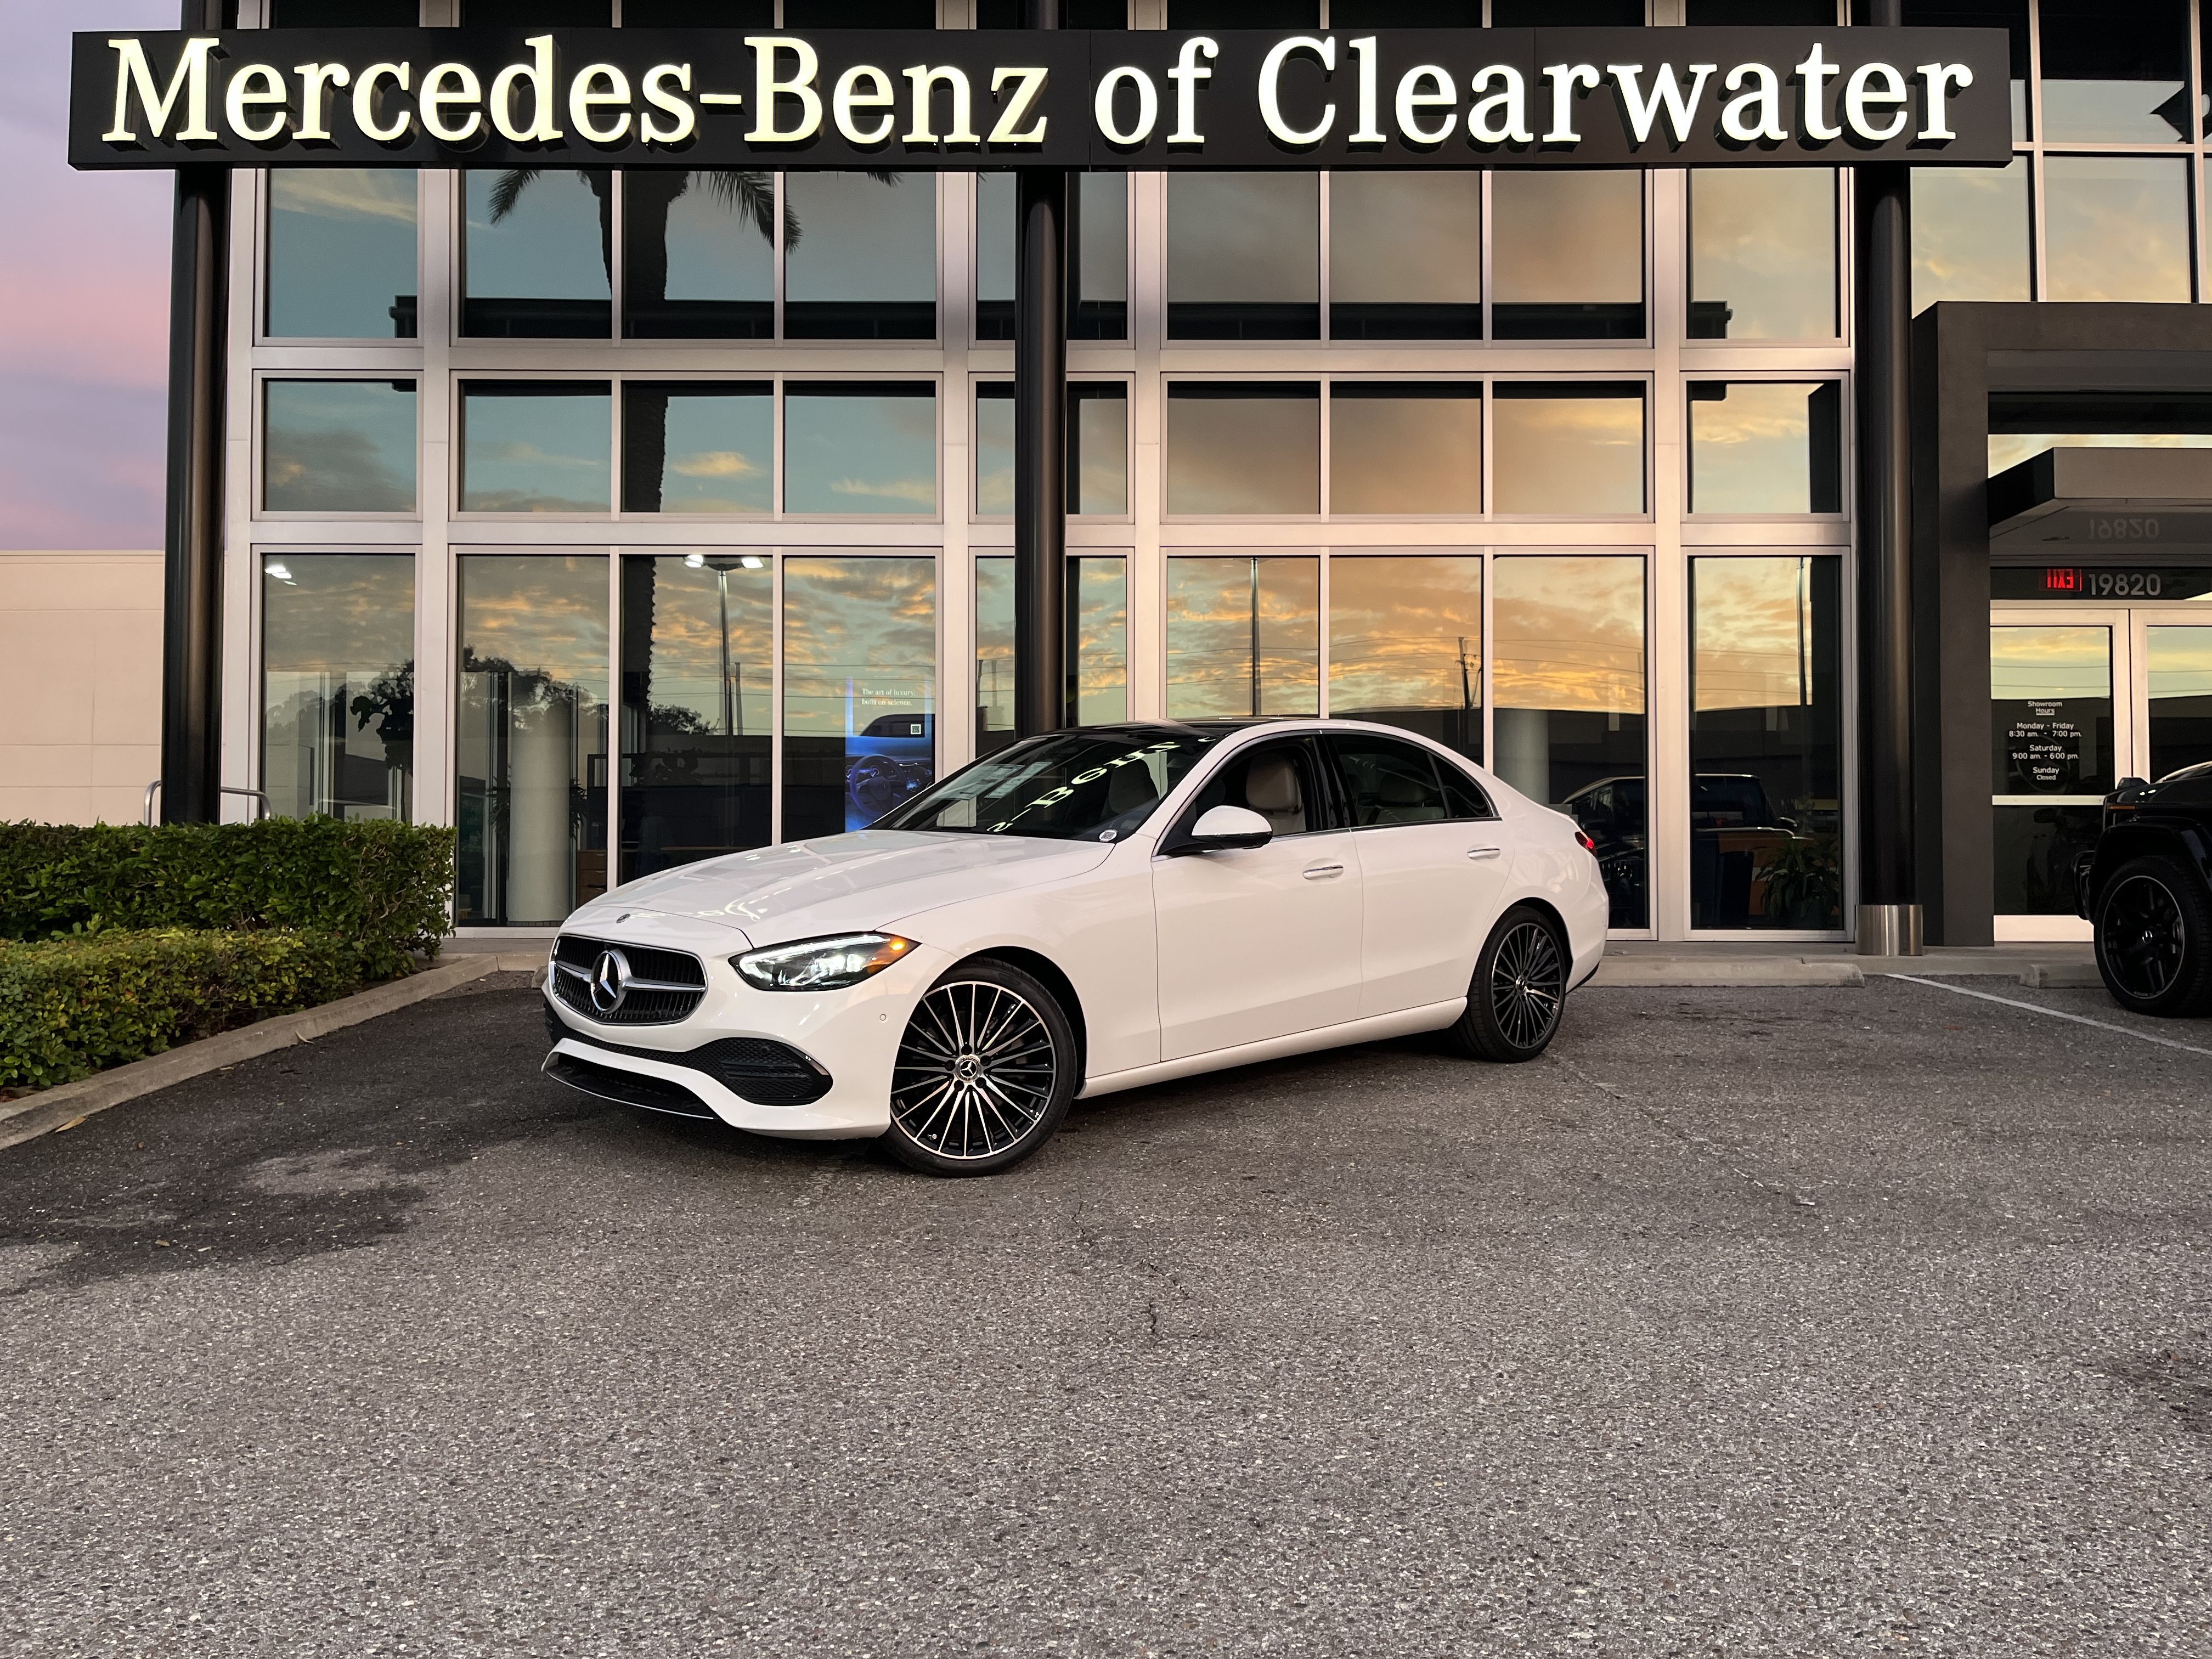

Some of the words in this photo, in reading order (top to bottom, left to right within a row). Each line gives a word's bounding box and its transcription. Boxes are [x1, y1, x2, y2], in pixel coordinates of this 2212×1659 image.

[102, 34, 1048, 145] Mercedes-Benz
[1094, 37, 1219, 144] of
[1258, 36, 1973, 144] Clearwater
[2089, 574, 2161, 596] 19820
